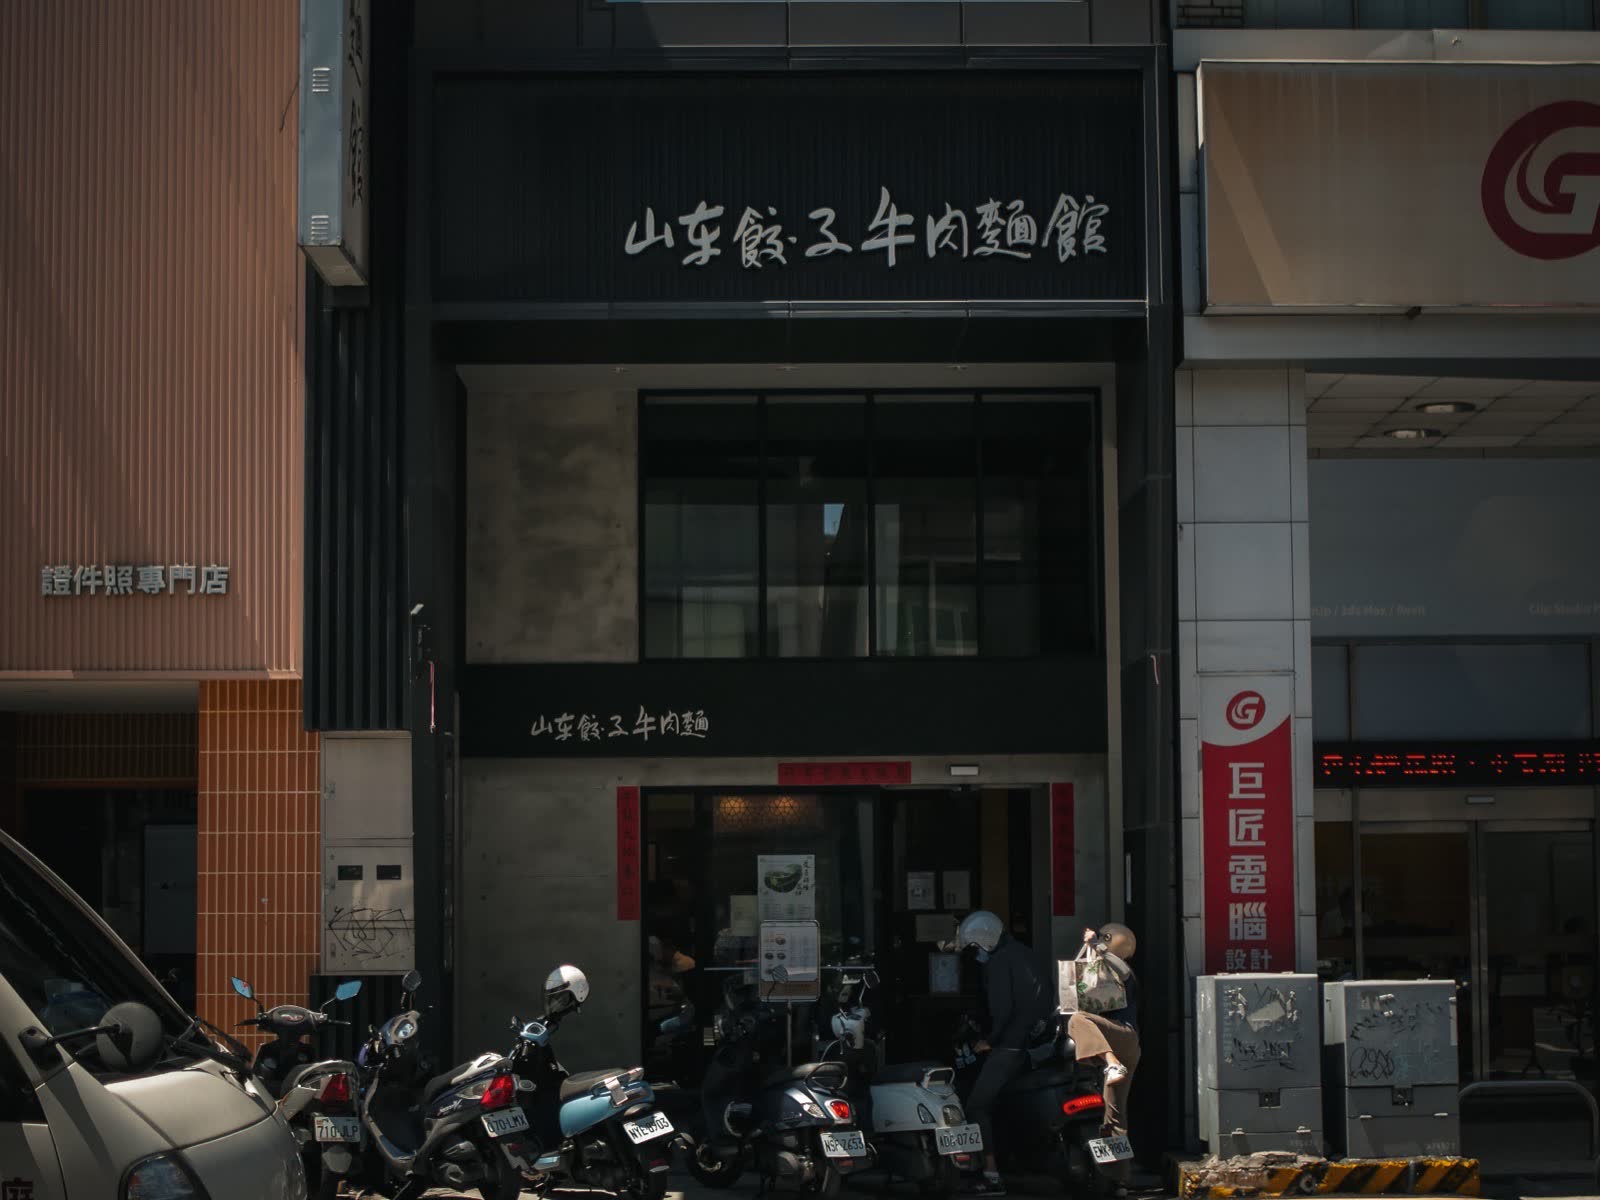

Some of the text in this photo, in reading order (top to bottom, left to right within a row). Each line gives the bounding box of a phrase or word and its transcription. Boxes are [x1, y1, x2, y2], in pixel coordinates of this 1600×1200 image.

[42, 563, 229, 596] 證件照專門店
[1228, 762, 1267, 940] 巨匠電腦
[1225, 948, 1272, 971] 設計
